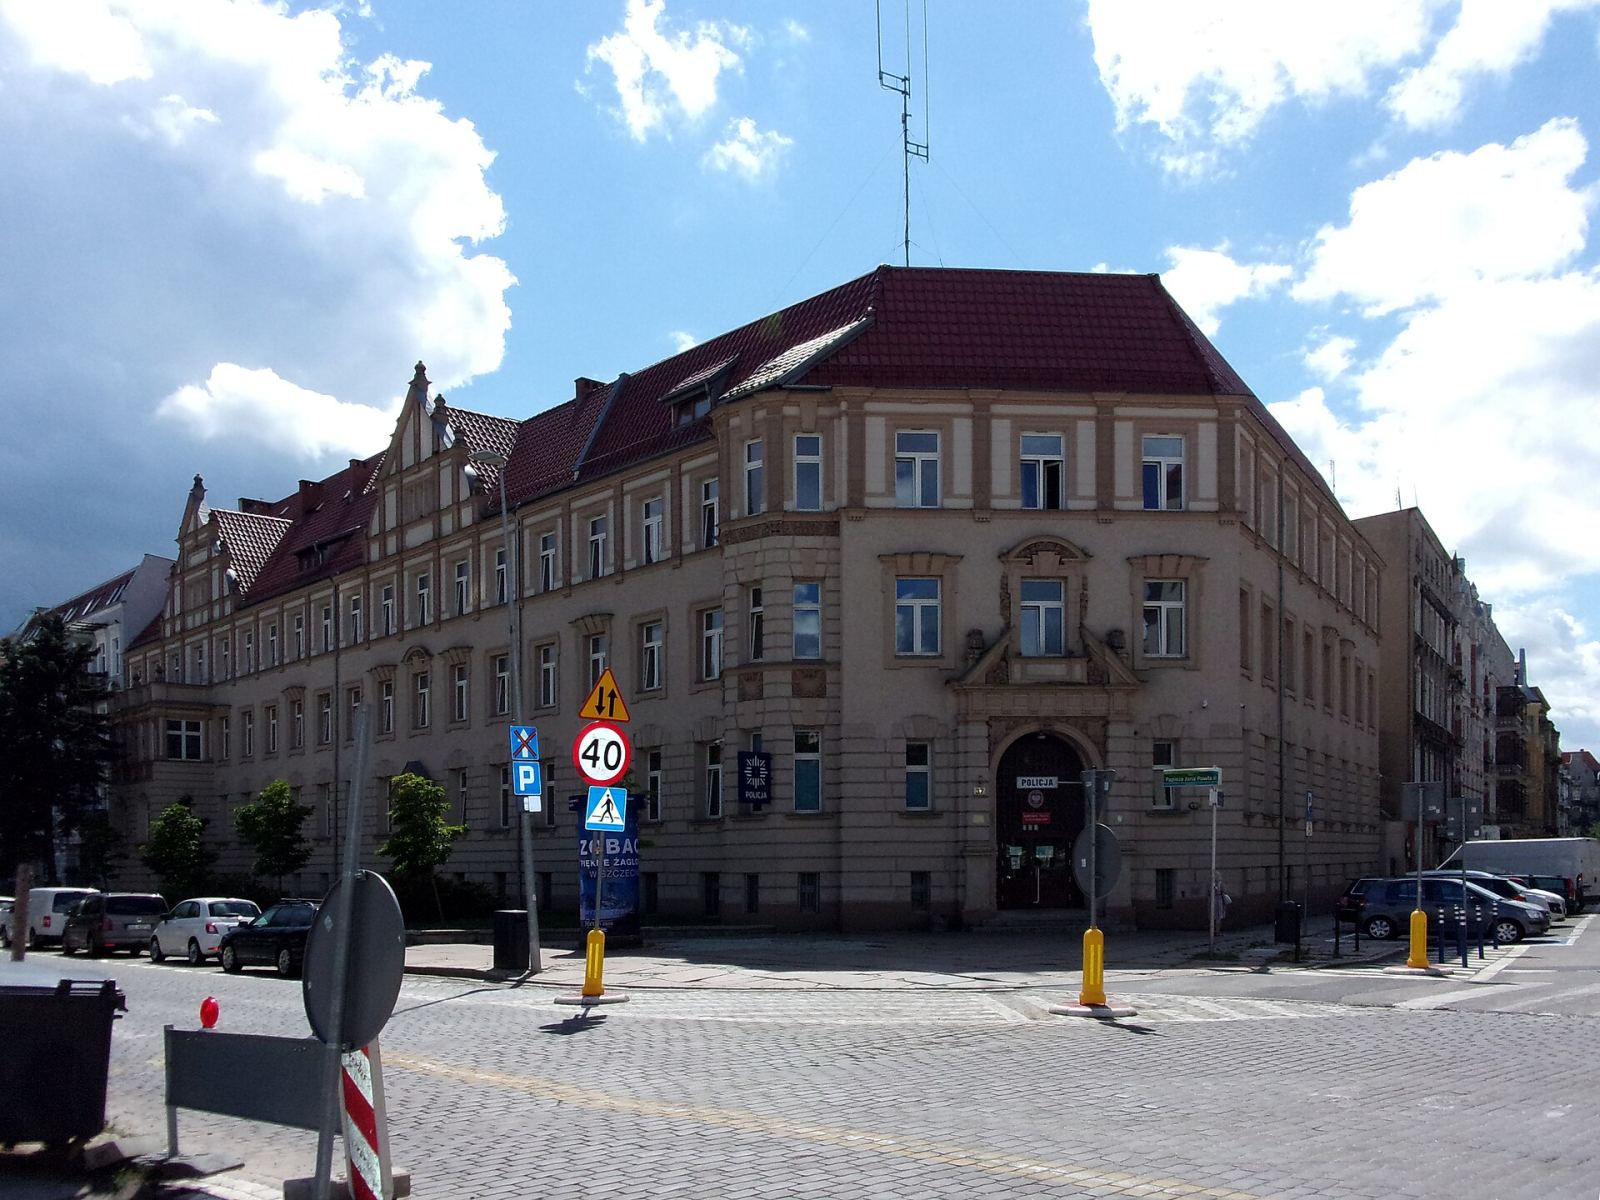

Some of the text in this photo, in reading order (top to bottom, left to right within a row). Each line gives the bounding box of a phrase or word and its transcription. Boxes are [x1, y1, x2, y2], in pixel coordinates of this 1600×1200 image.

[582, 738, 622, 771] 40
[519, 765, 535, 791] P
[1021, 778, 1054, 787] POLICJA
[745, 791, 768, 799] POLICJA
